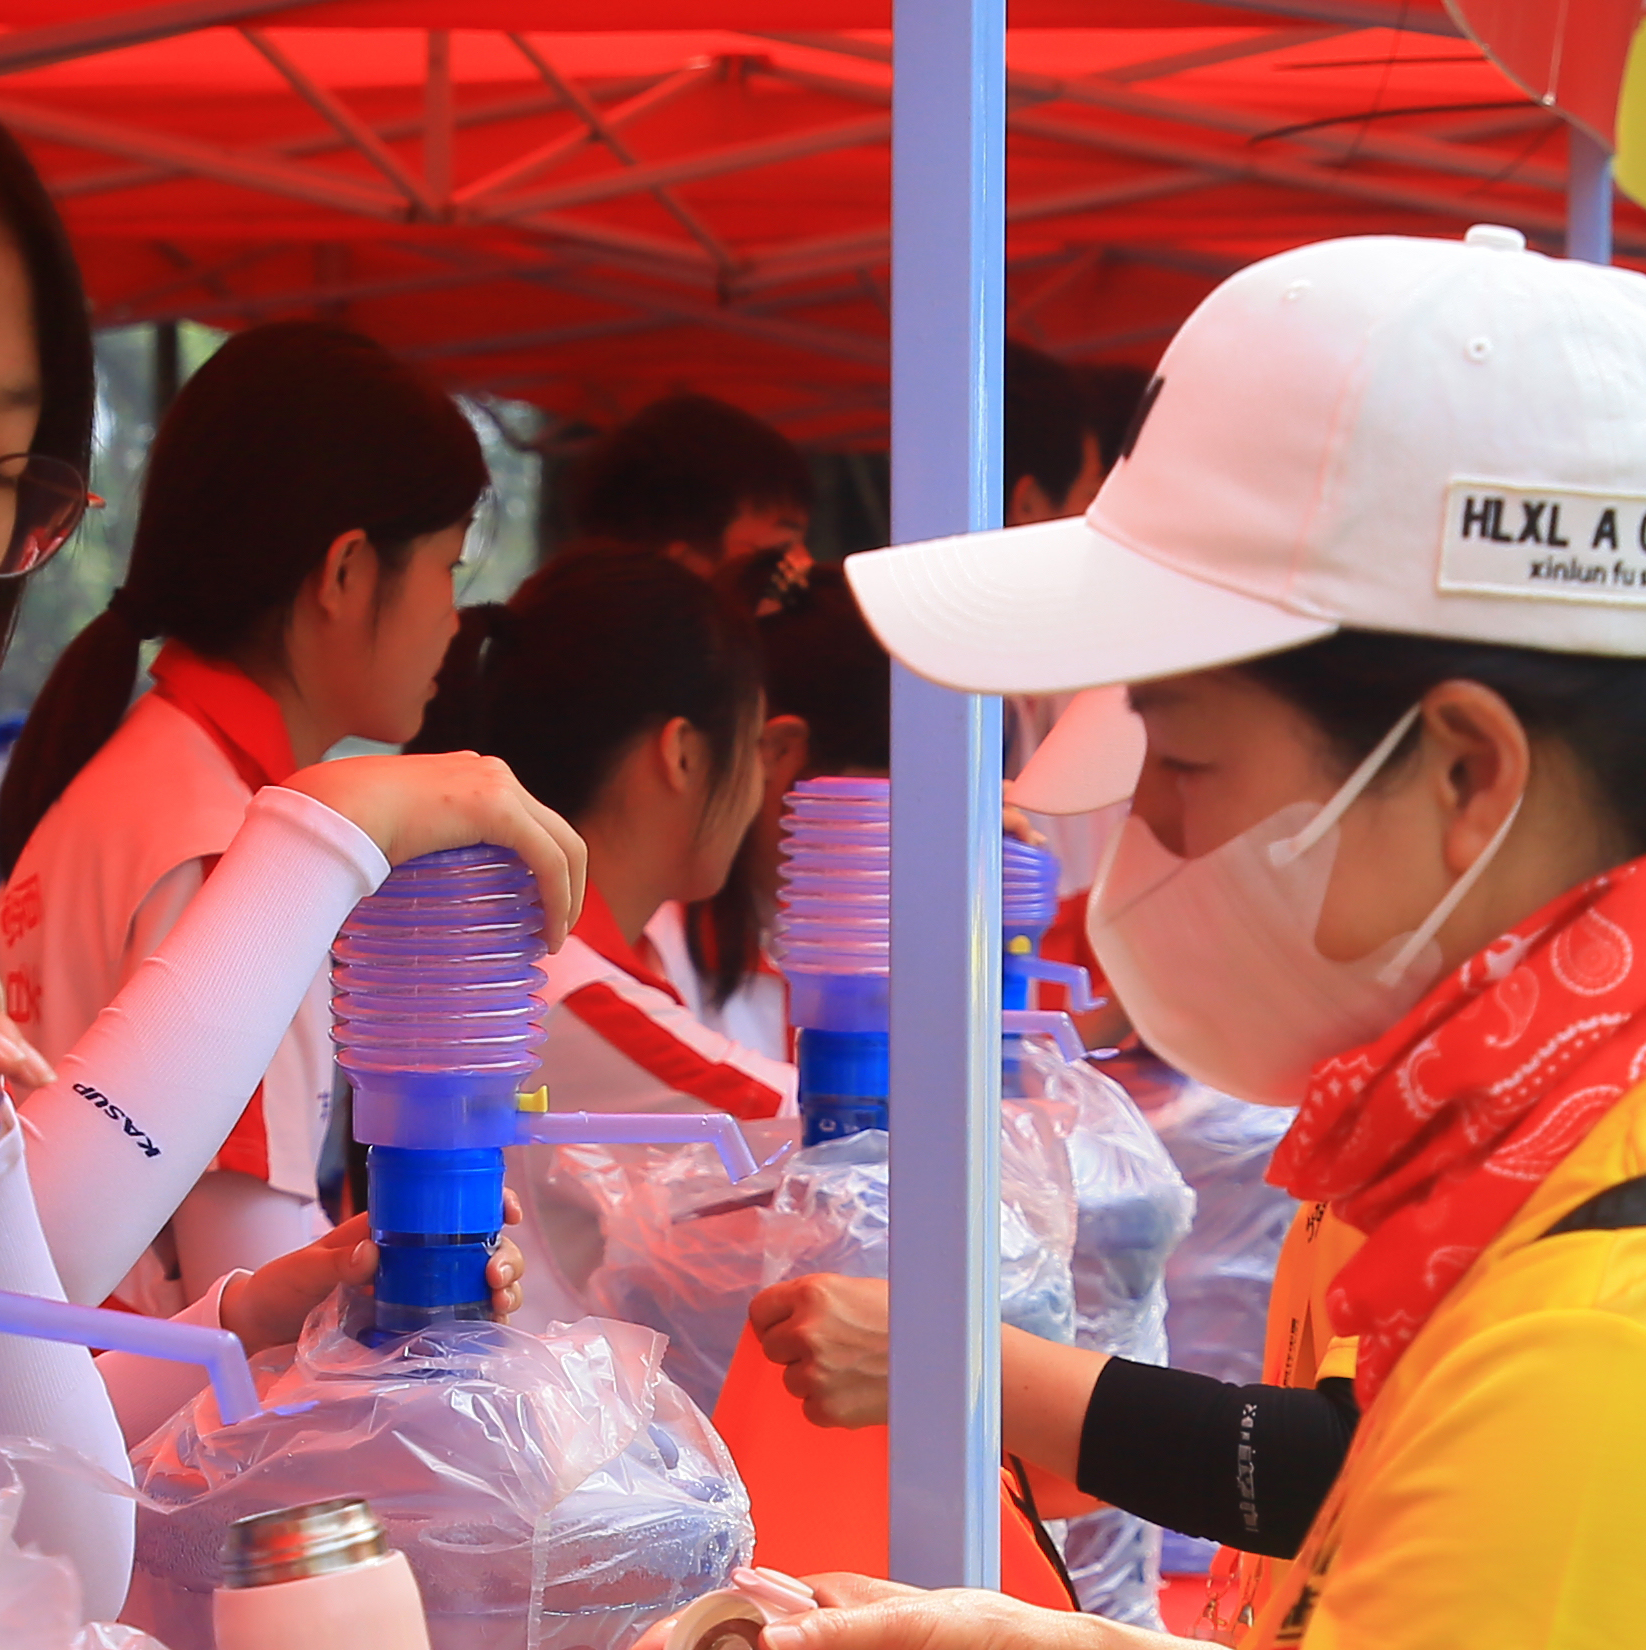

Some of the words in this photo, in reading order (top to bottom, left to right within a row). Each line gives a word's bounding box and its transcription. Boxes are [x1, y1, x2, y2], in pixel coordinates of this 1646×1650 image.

[1462, 496, 1569, 547] HLXL
[1591, 508, 1620, 551] A
[72, 1083, 161, 1158] KASUP
